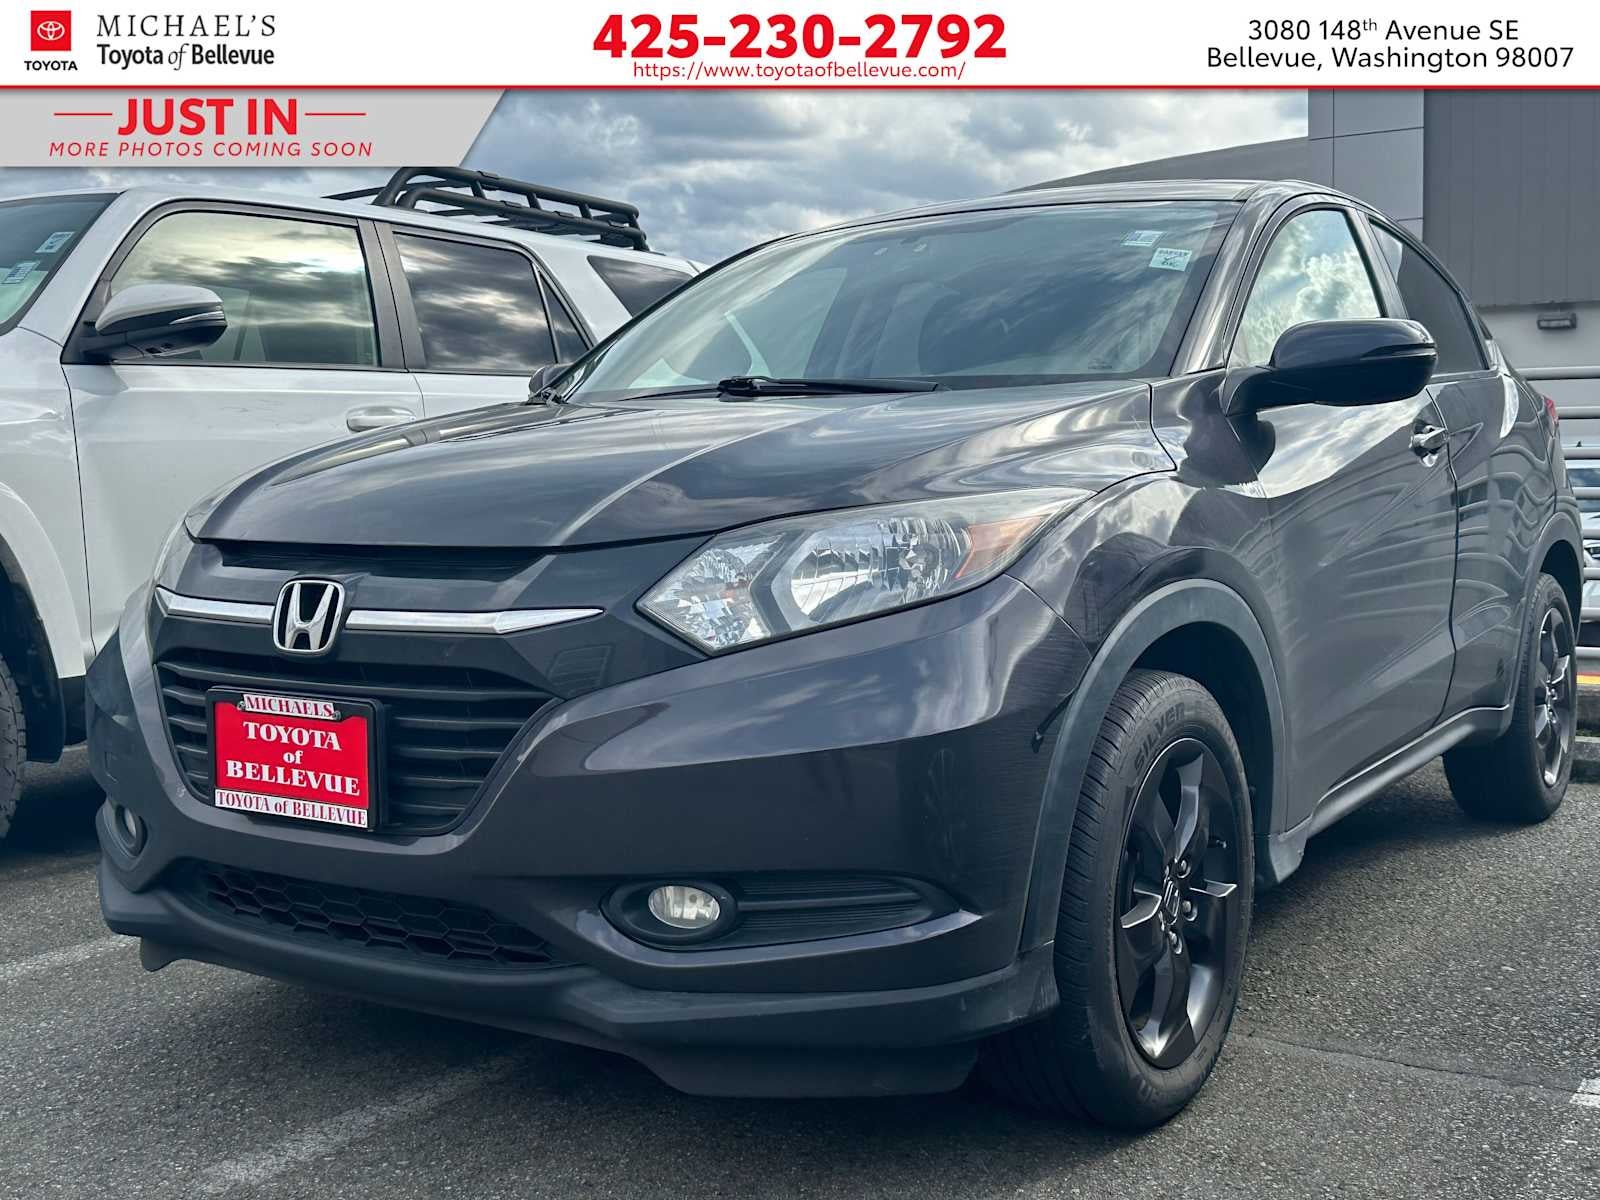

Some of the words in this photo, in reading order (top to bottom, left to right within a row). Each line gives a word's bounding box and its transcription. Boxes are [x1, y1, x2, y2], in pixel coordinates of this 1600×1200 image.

[245, 695, 334, 718] MICHAELS
[243, 720, 342, 751] TOYOTA
[282, 750, 304, 764] of
[225, 759, 361, 797] BELLEVUE
[216, 791, 271, 812] TOYOTA
[274, 800, 290, 814] of
[293, 802, 367, 826] BELLEVUE
